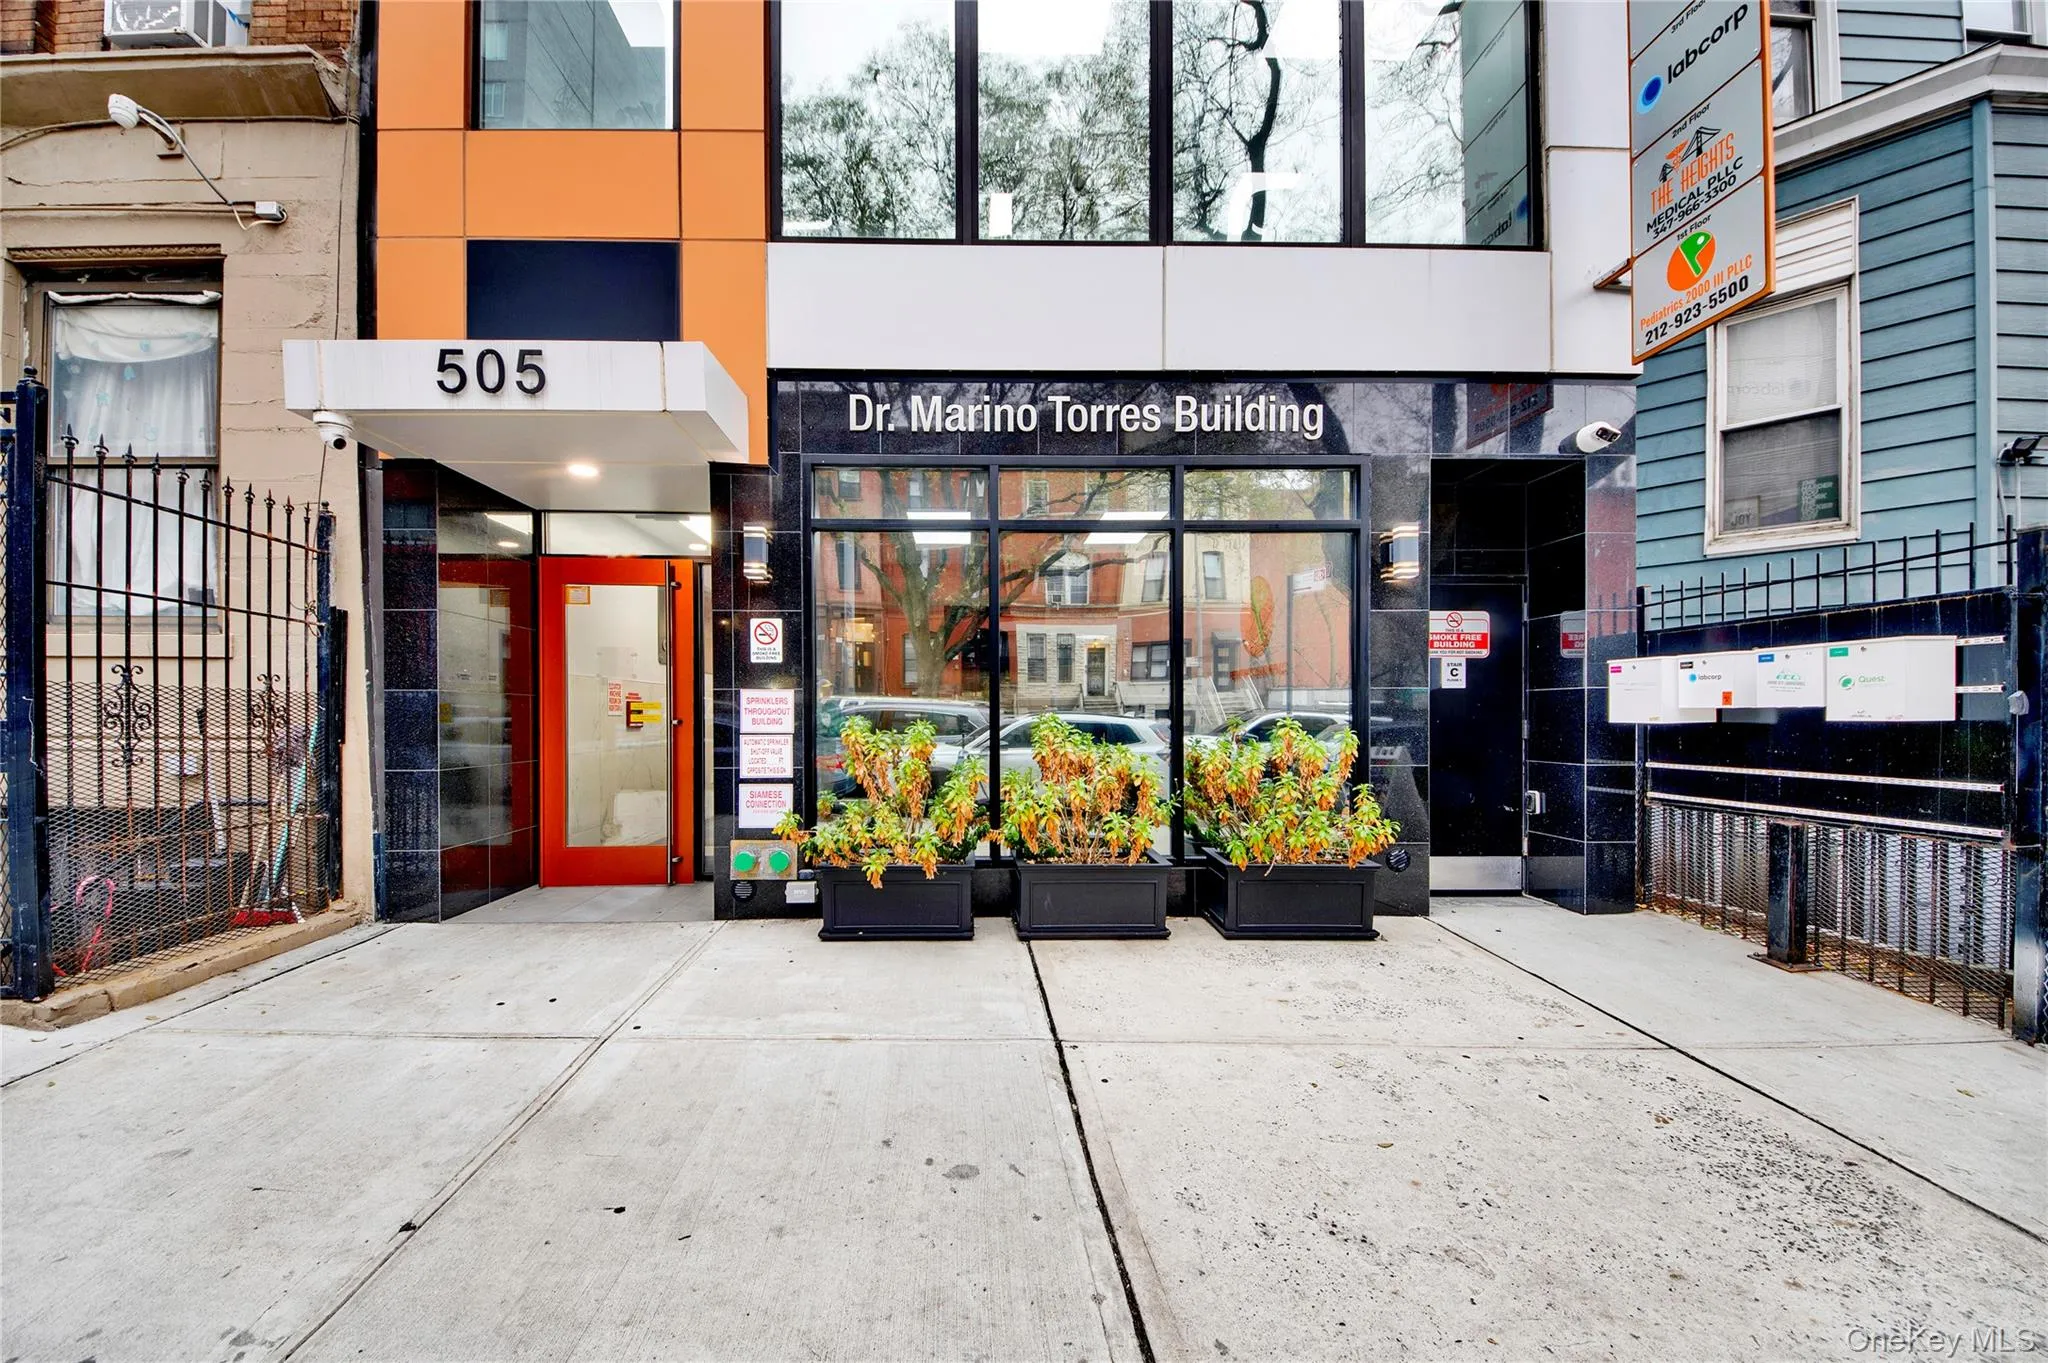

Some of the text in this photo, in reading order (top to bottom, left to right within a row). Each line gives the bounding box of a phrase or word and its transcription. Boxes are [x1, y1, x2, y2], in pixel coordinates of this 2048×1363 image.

[1670, 15, 1685, 34] 3rd
[1667, 3, 1749, 84] labcorp
[1671, 102, 1712, 139] 2nd Floor
[1650, 132, 1736, 215] THE HEIGHTS
[1646, 156, 1744, 233] MEDICAL PLLC
[1652, 174, 1737, 240] 347-966-3300
[1676, 213, 1712, 241] 1st Floor
[1640, 297, 1684, 331] Pediatrics
[1686, 281, 1711, 304] 2000
[1727, 254, 1753, 281] PLLC
[1645, 275, 1749, 346] 212-923-5500
[436, 348, 546, 395] 505
[848, 394, 1324, 441] Dr. Marino Torres Building
[1731, 511, 1751, 527] JOY
[1450, 667, 1459, 677] C
[1698, 673, 1722, 681] labcorp
[1858, 674, 1886, 684] Quest
[744, 707, 791, 715] THROUGHOUT
[746, 696, 788, 705] SPRINKLERS
[752, 717, 783, 725] BUILDING
[745, 799, 787, 808] CONNECTION
[749, 790, 782, 799] SIAMESE
